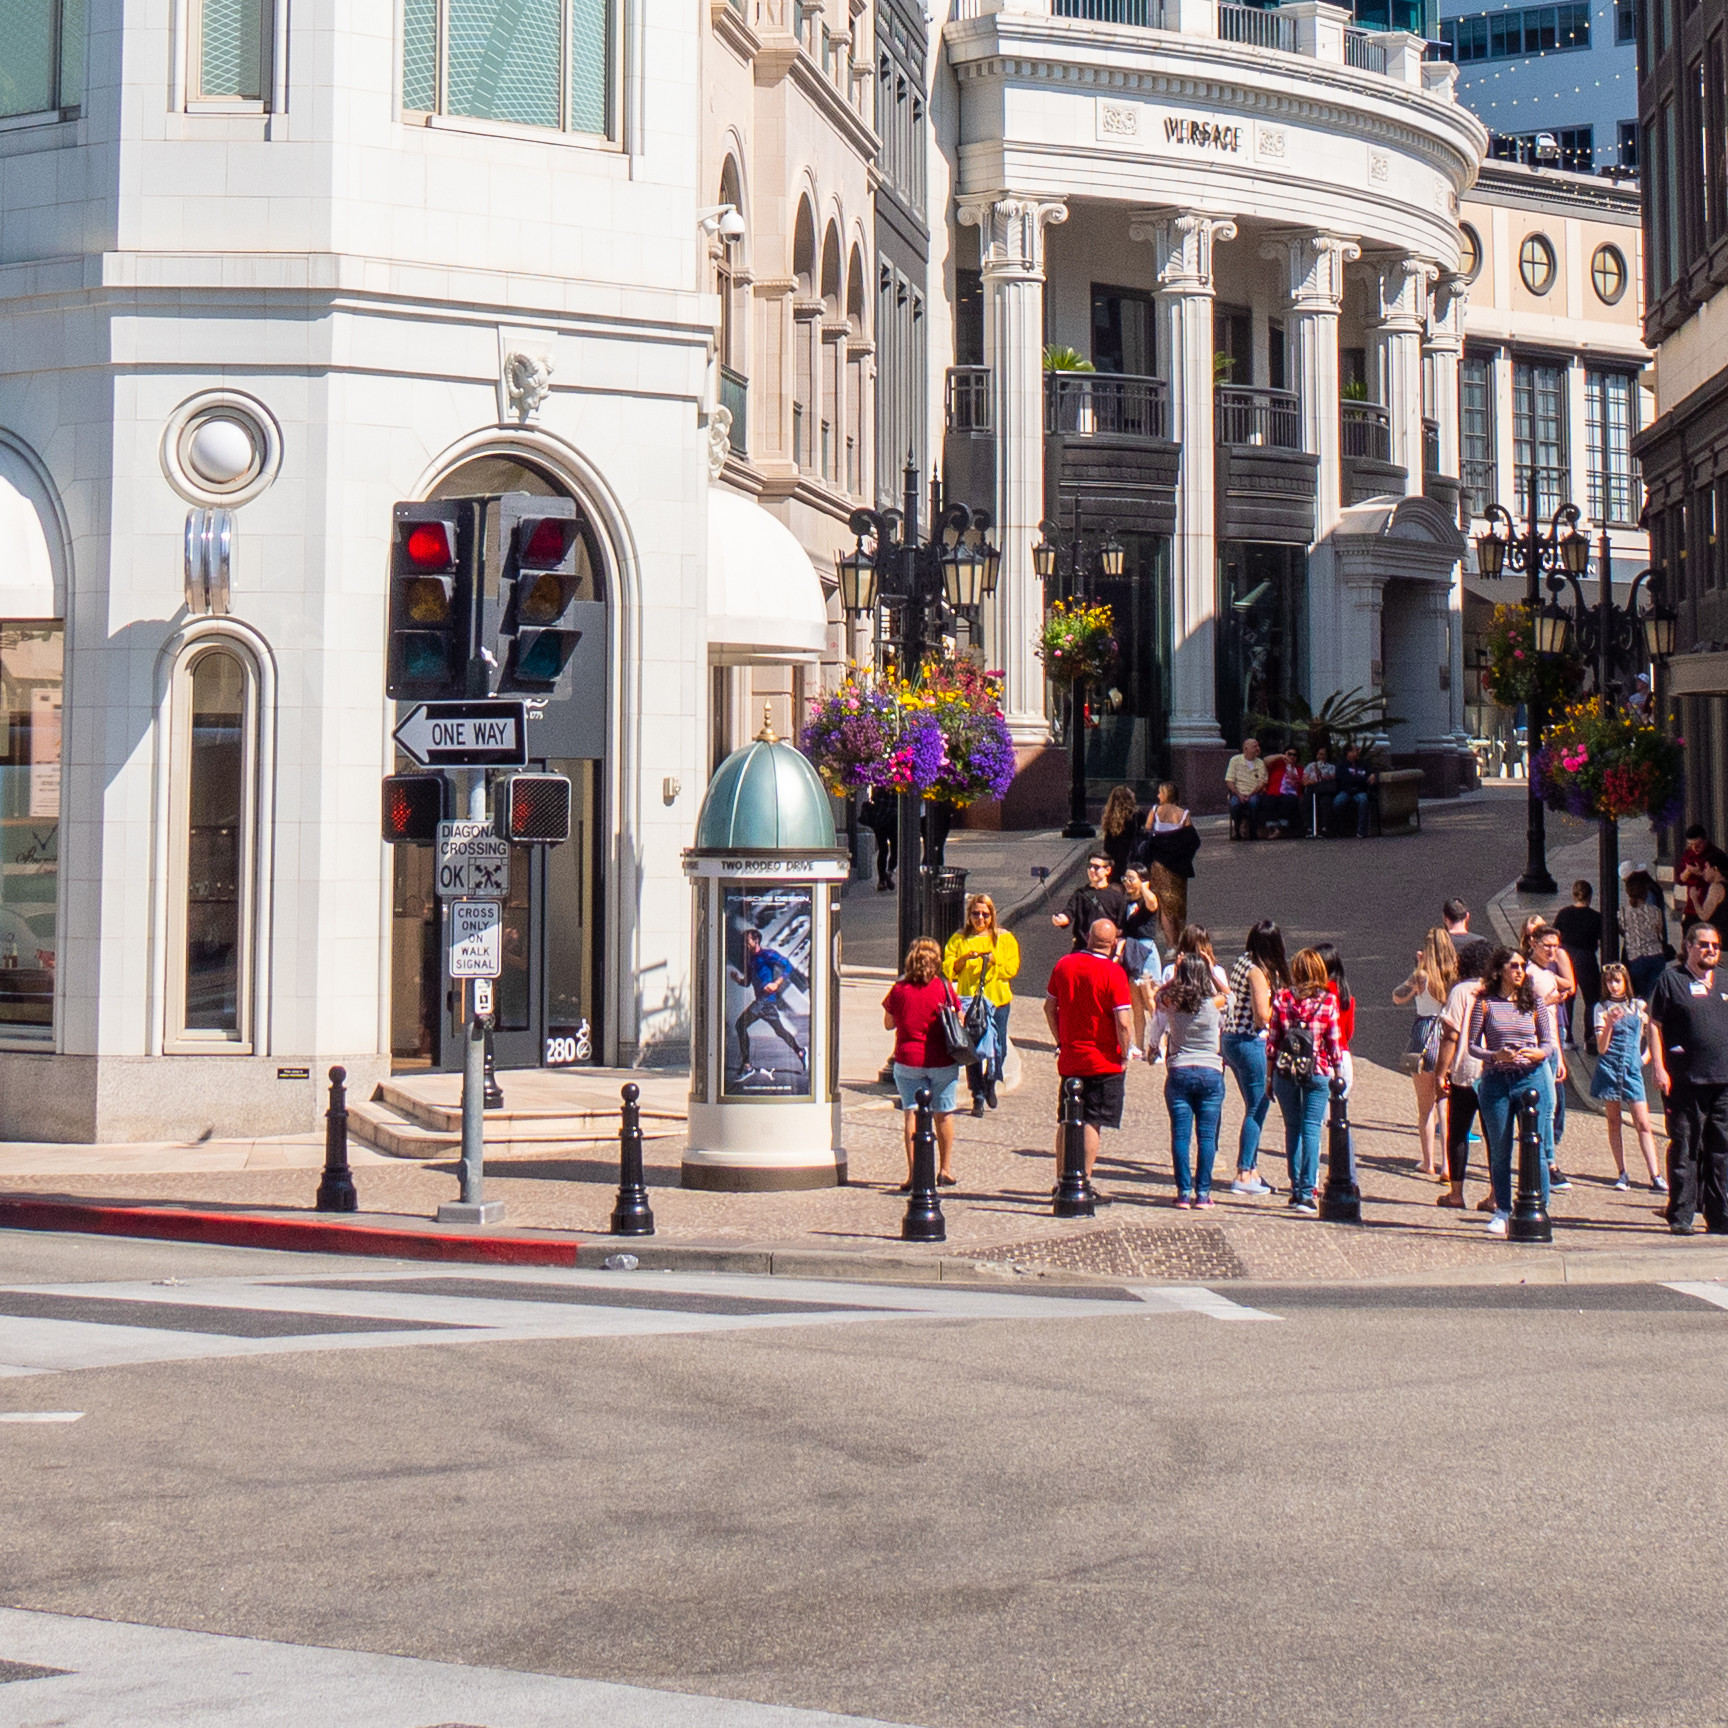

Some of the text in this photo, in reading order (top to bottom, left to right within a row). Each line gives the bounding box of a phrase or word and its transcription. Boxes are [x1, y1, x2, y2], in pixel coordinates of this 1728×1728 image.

[1163, 116, 1243, 150] VERSACE
[432, 722, 508, 745] ONE WAY
[442, 825, 495, 838] DIAGONA
[440, 842, 507, 856] CROSSING
[721, 860, 743, 870] TWO
[745, 860, 781, 871] RODEO
[440, 864, 465, 888] OK
[458, 907, 494, 919] CROSS
[461, 921, 490, 931] ONLY
[468, 933, 484, 944] ON
[461, 946, 490, 957] WALK
[456, 959, 495, 970] SIGNAL
[547, 1037, 576, 1063] 280
